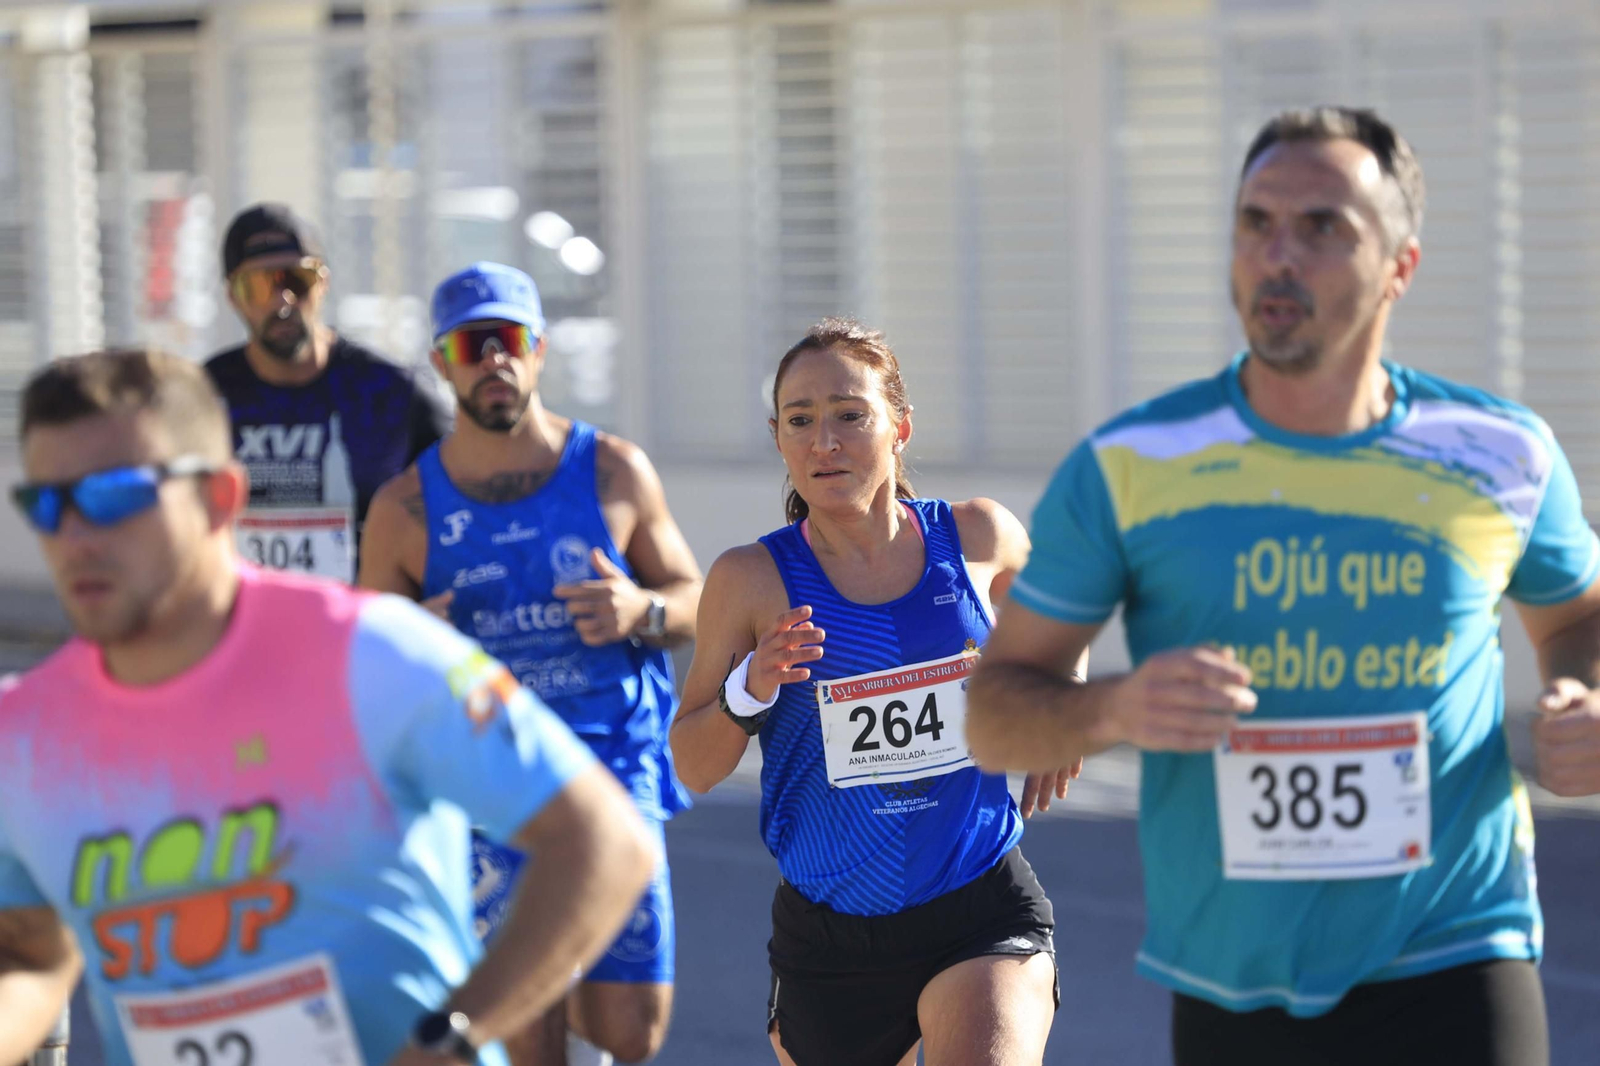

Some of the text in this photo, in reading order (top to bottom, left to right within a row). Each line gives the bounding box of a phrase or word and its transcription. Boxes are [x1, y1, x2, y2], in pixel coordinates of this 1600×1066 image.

[236, 423, 325, 459] XVI
[1233, 535, 1427, 611] ¡Ojú que
[853, 678, 901, 693] CARRERA
[902, 671, 920, 684] DEL
[1236, 629, 1346, 690] eblo
[849, 692, 944, 752] 264
[848, 756, 868, 766] ANA
[869, 750, 927, 763] INMACULADA
[872, 806, 909, 815] VETERANOS
[885, 796, 928, 808] CLUB ATLETAS
[1250, 763, 1368, 831] 385
[92, 879, 295, 982] STOP
